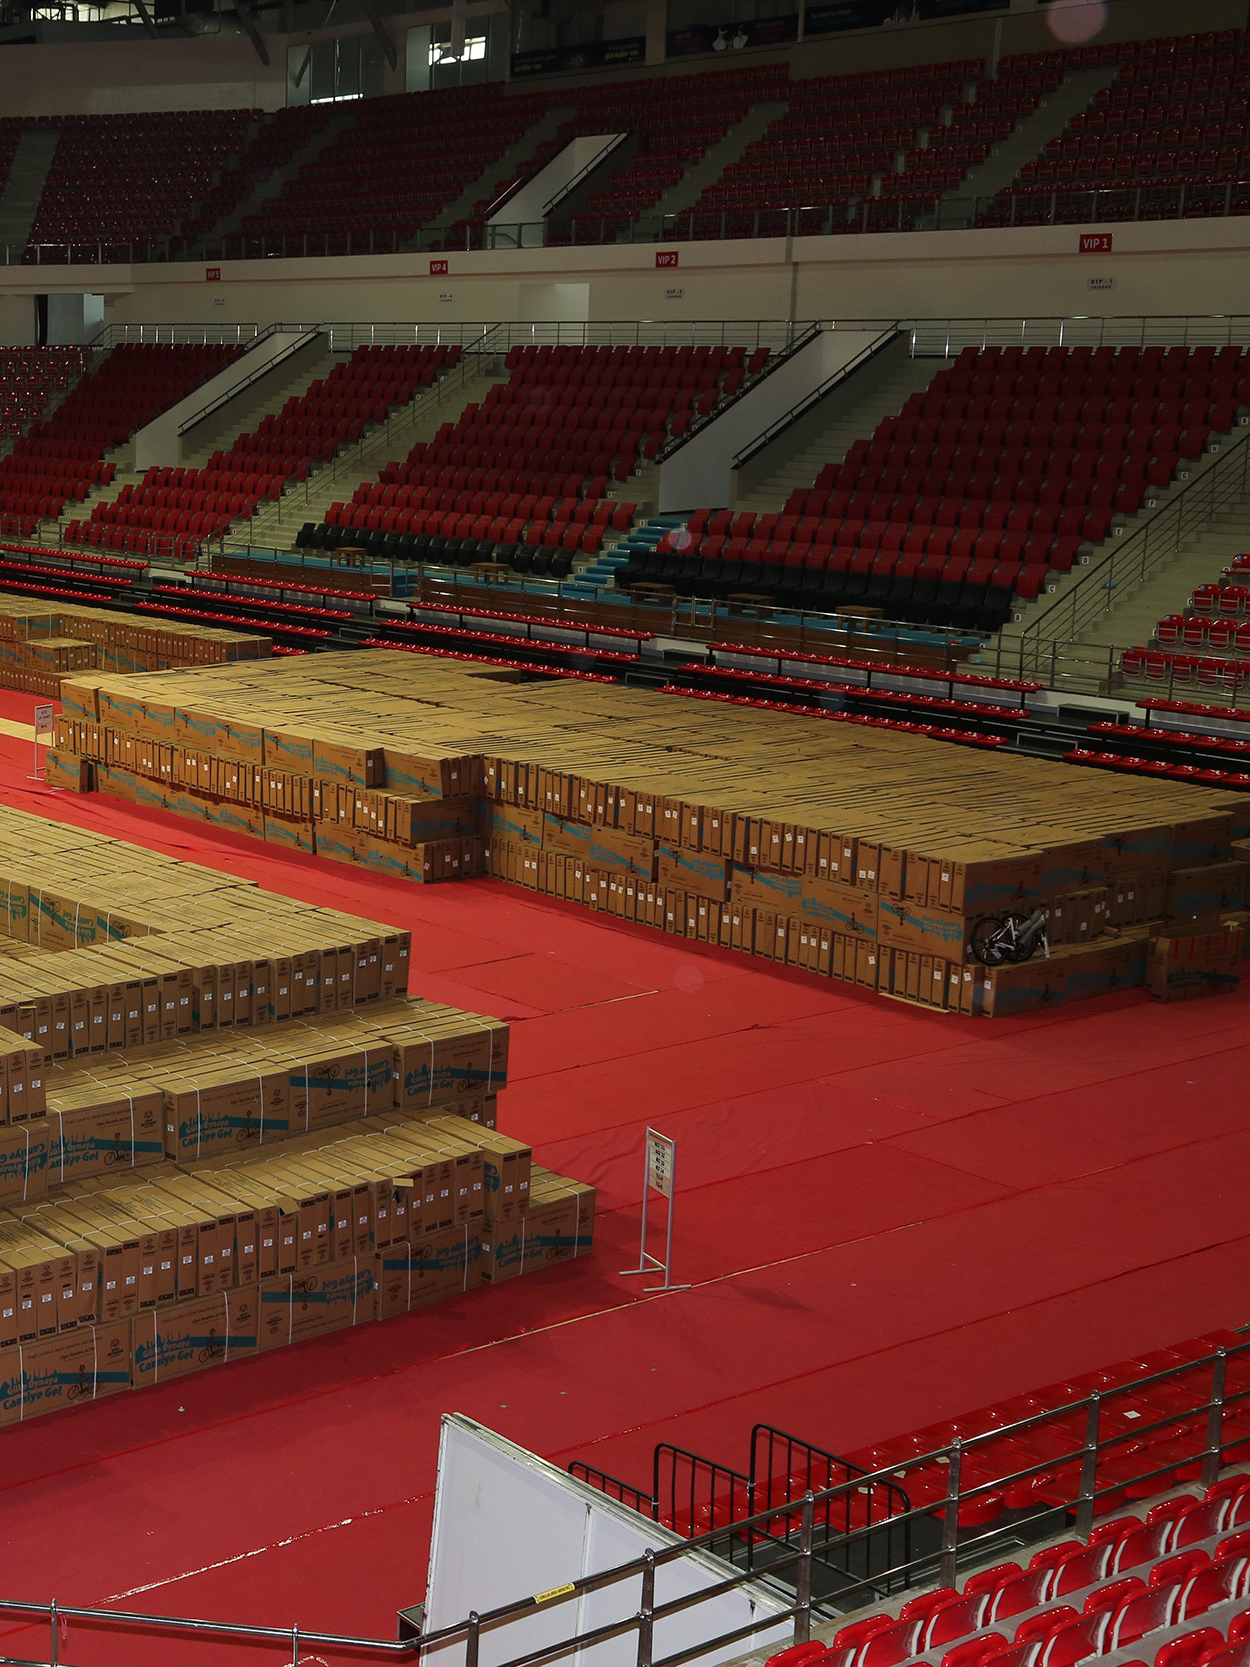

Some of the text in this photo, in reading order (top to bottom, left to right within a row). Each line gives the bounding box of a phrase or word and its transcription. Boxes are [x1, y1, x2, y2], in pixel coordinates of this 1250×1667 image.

[1083, 238, 1108, 249] VIP 1
[658, 255, 676, 264] VIP 2
[432, 264, 441, 272] VIP
[217, 1128, 232, 1139] Gel
[48, 1149, 99, 1170] amiye Gel
[176, 1350, 194, 1360] Gel
[3, 1386, 62, 1410] Camiye Gel
